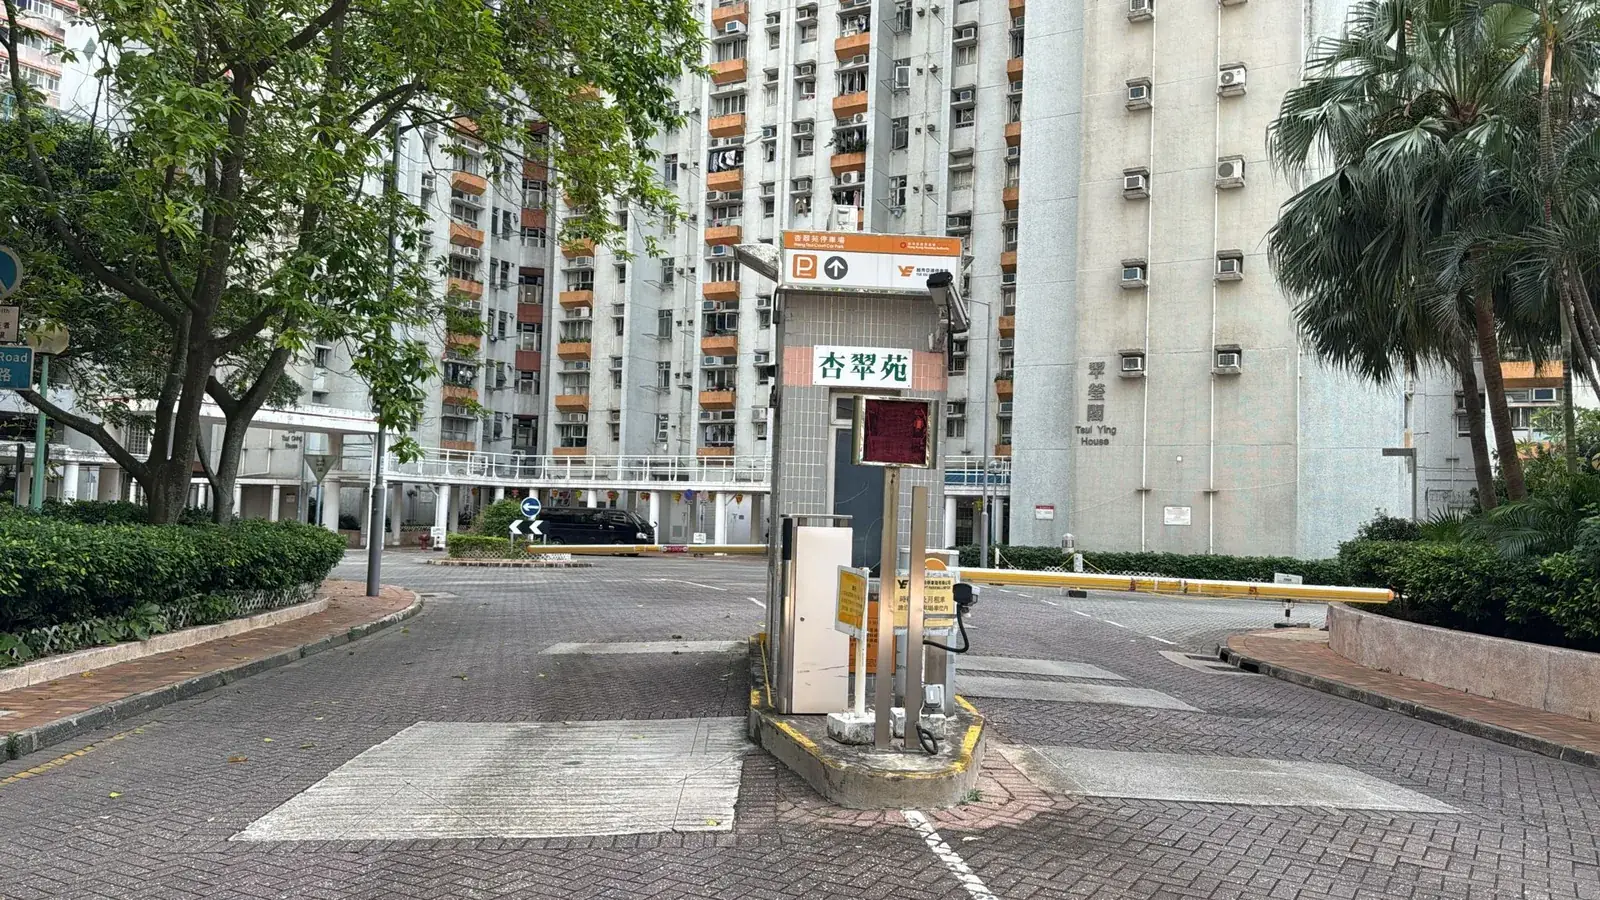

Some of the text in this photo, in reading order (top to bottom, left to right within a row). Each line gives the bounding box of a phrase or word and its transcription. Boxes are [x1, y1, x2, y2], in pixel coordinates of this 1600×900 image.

[794, 234, 845, 244] 杏翠苑停車場
[796, 256, 813, 276] P
[0, 352, 28, 362] Road
[818, 351, 909, 382] 杏翠苑
[1075, 425, 1117, 436] Tsui Ying
[1081, 437, 1109, 446] House
